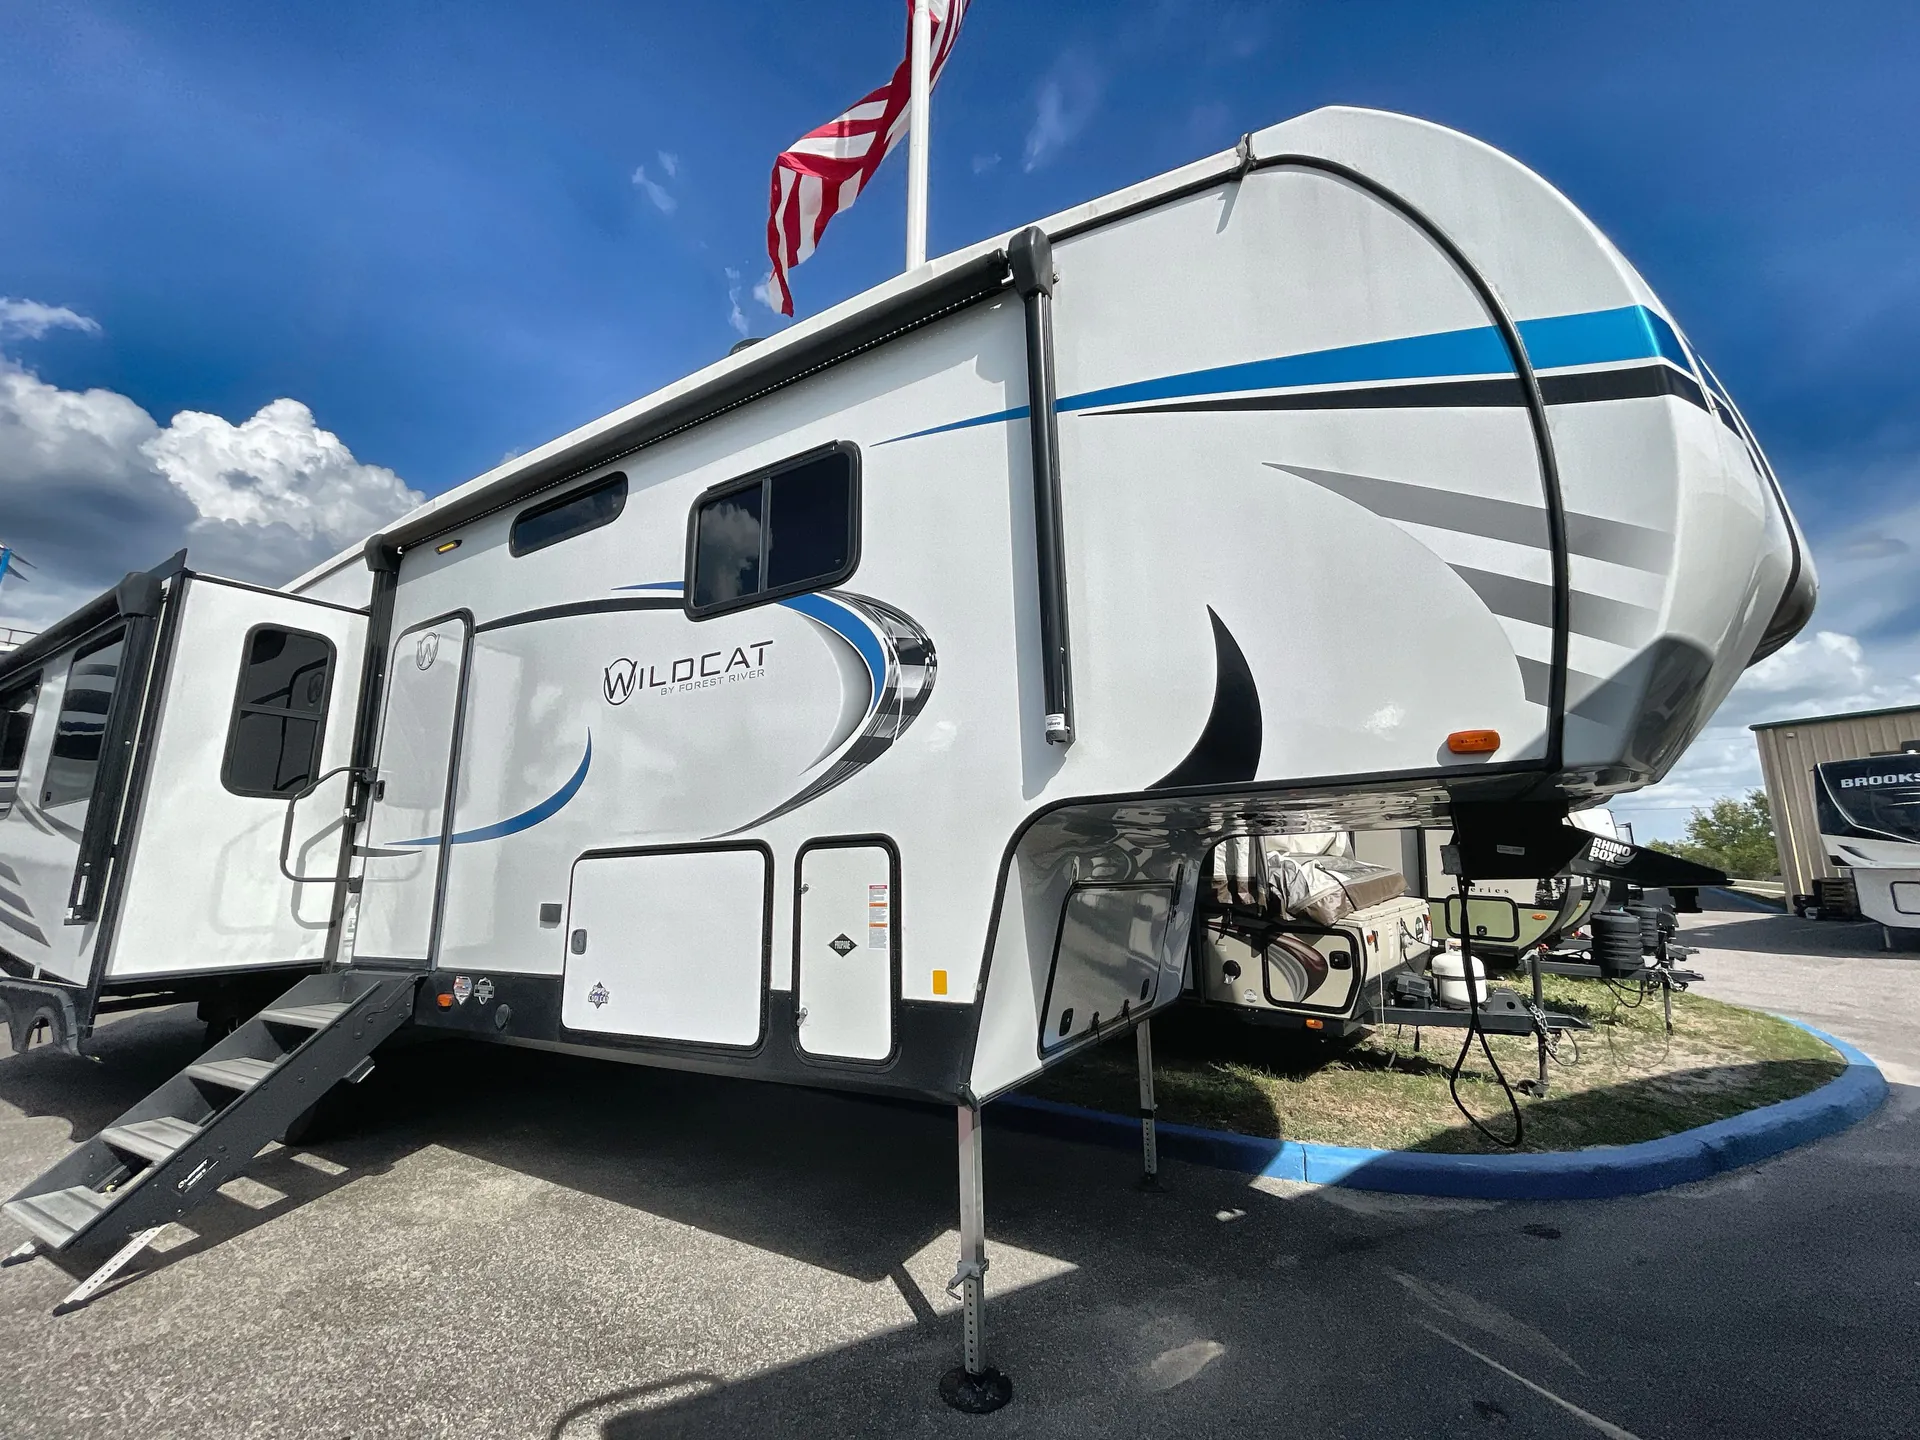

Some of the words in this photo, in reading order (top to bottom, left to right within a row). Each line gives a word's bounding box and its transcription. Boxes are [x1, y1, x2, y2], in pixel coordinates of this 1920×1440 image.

[603, 640, 774, 706] WILDCAT
[660, 686, 675, 696] BY
[679, 676, 725, 692] FOREST
[728, 669, 765, 683] RIVER
[1589, 846, 1617, 863] BOX
[1592, 837, 1631, 857] RHINO
